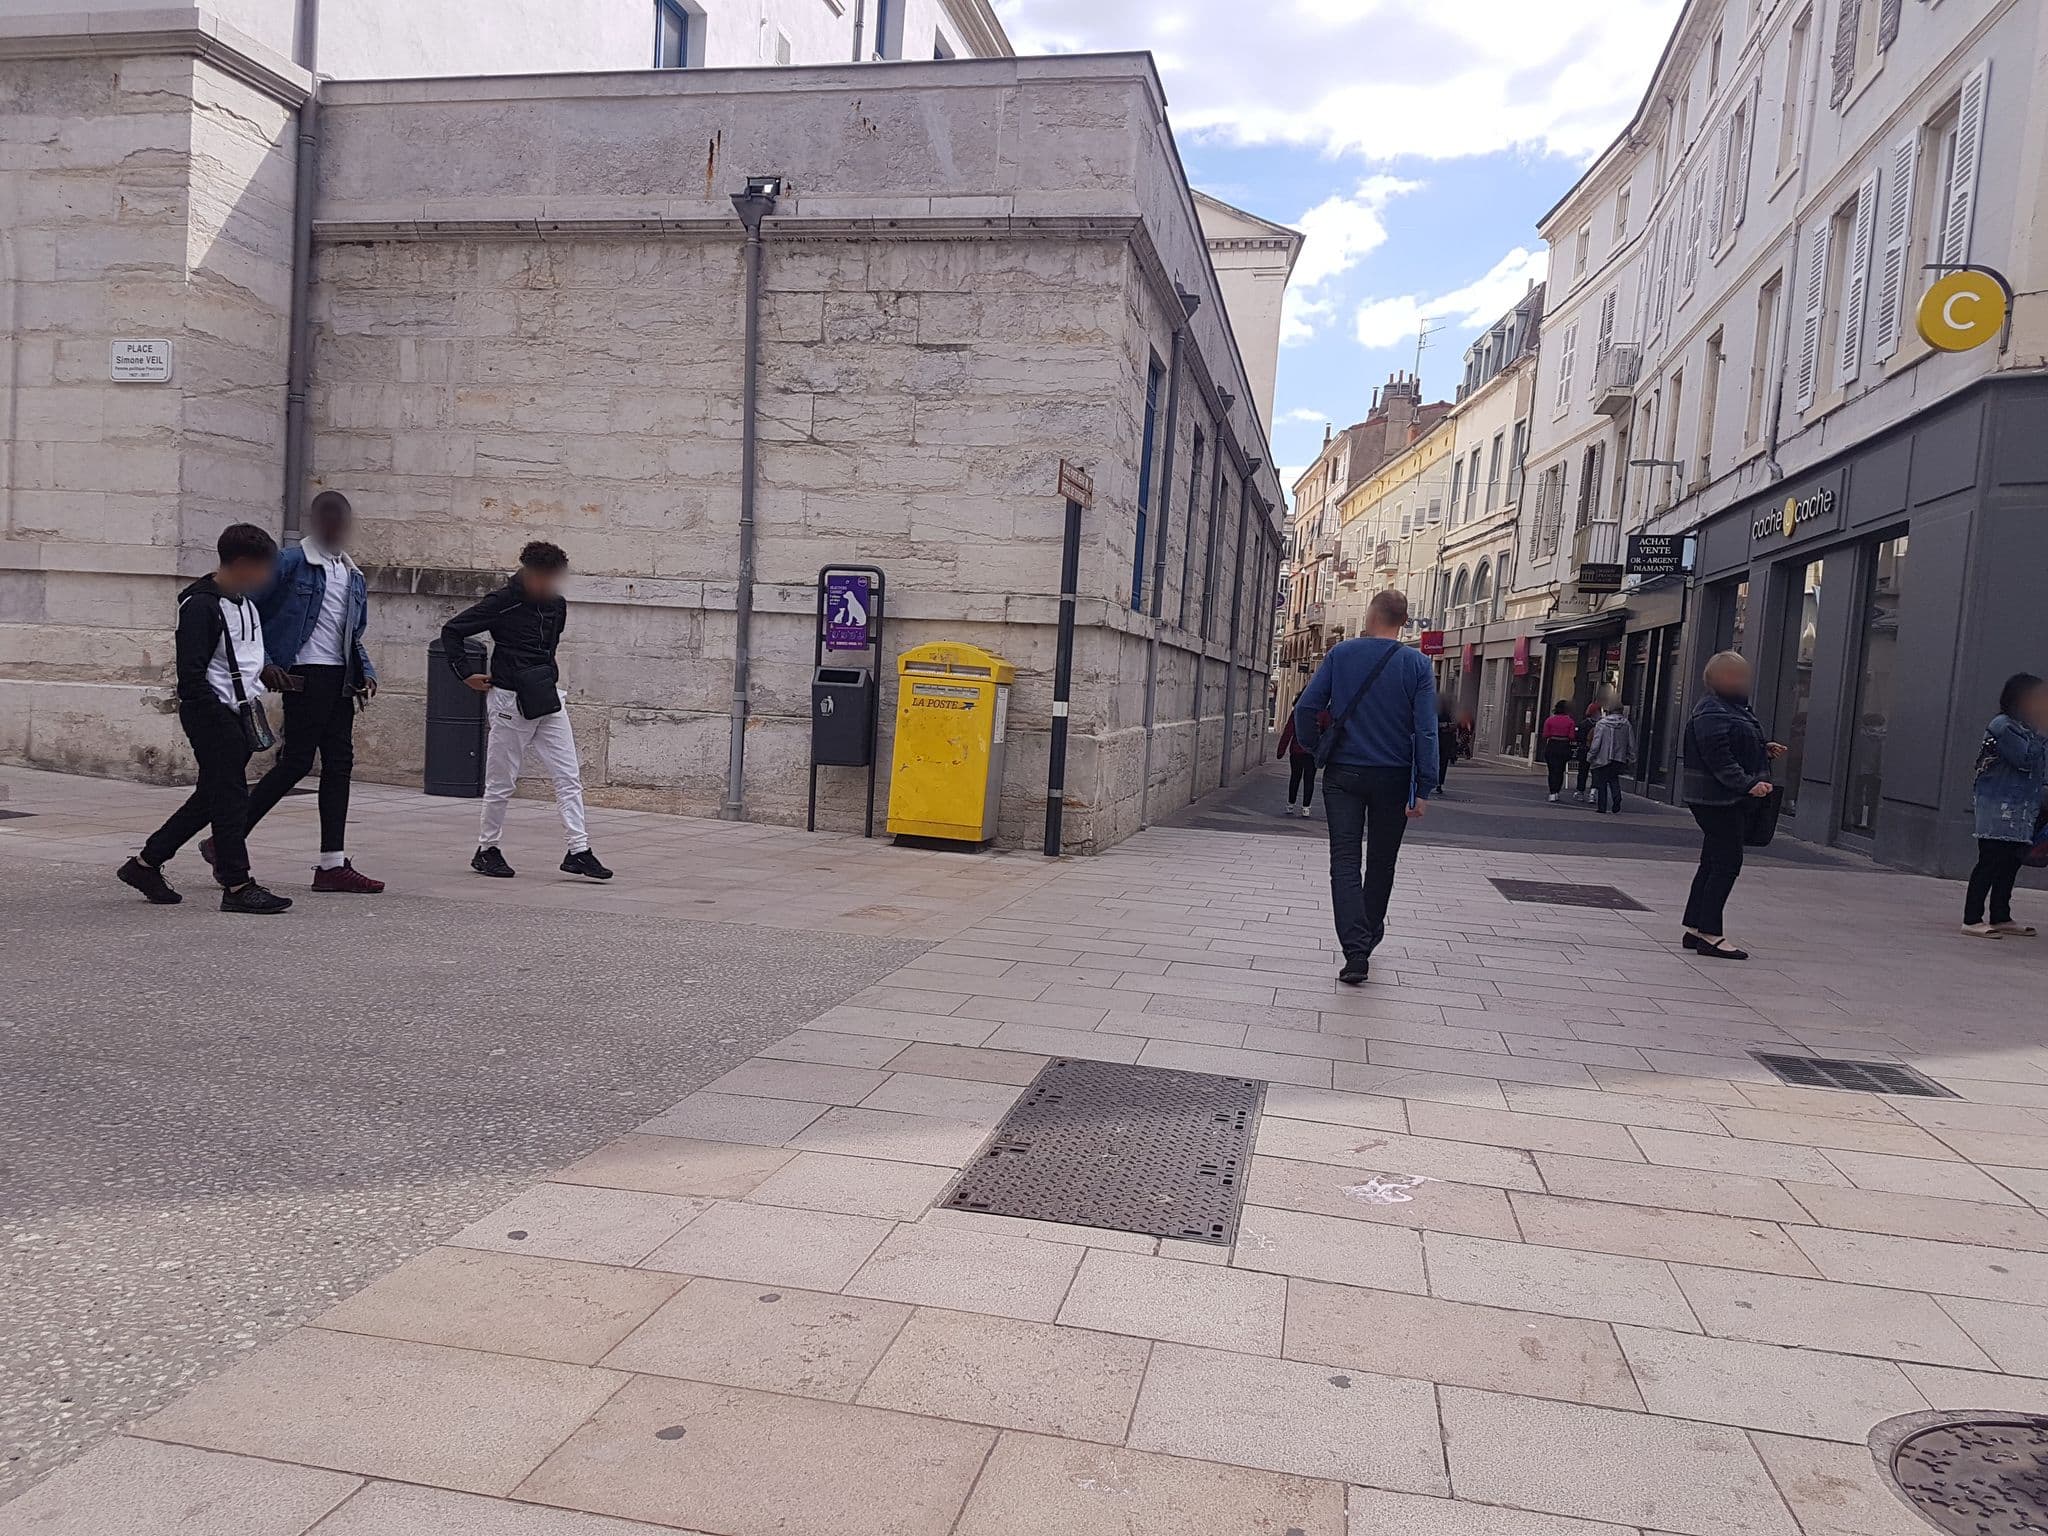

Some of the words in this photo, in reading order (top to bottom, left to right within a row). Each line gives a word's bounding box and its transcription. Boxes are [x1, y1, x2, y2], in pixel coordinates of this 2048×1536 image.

[1943, 291, 1981, 330] C
[127, 345, 153, 353] PLACE
[116, 356, 144, 364] Simone
[146, 356, 163, 364] VEIL
[1752, 508, 1783, 540] cache
[1794, 487, 1832, 523] cache
[1639, 537, 1671, 546] ACHAT
[1639, 546, 1671, 555] VENTE
[912, 698, 925, 707] LA
[926, 699, 958, 710] POSTE
